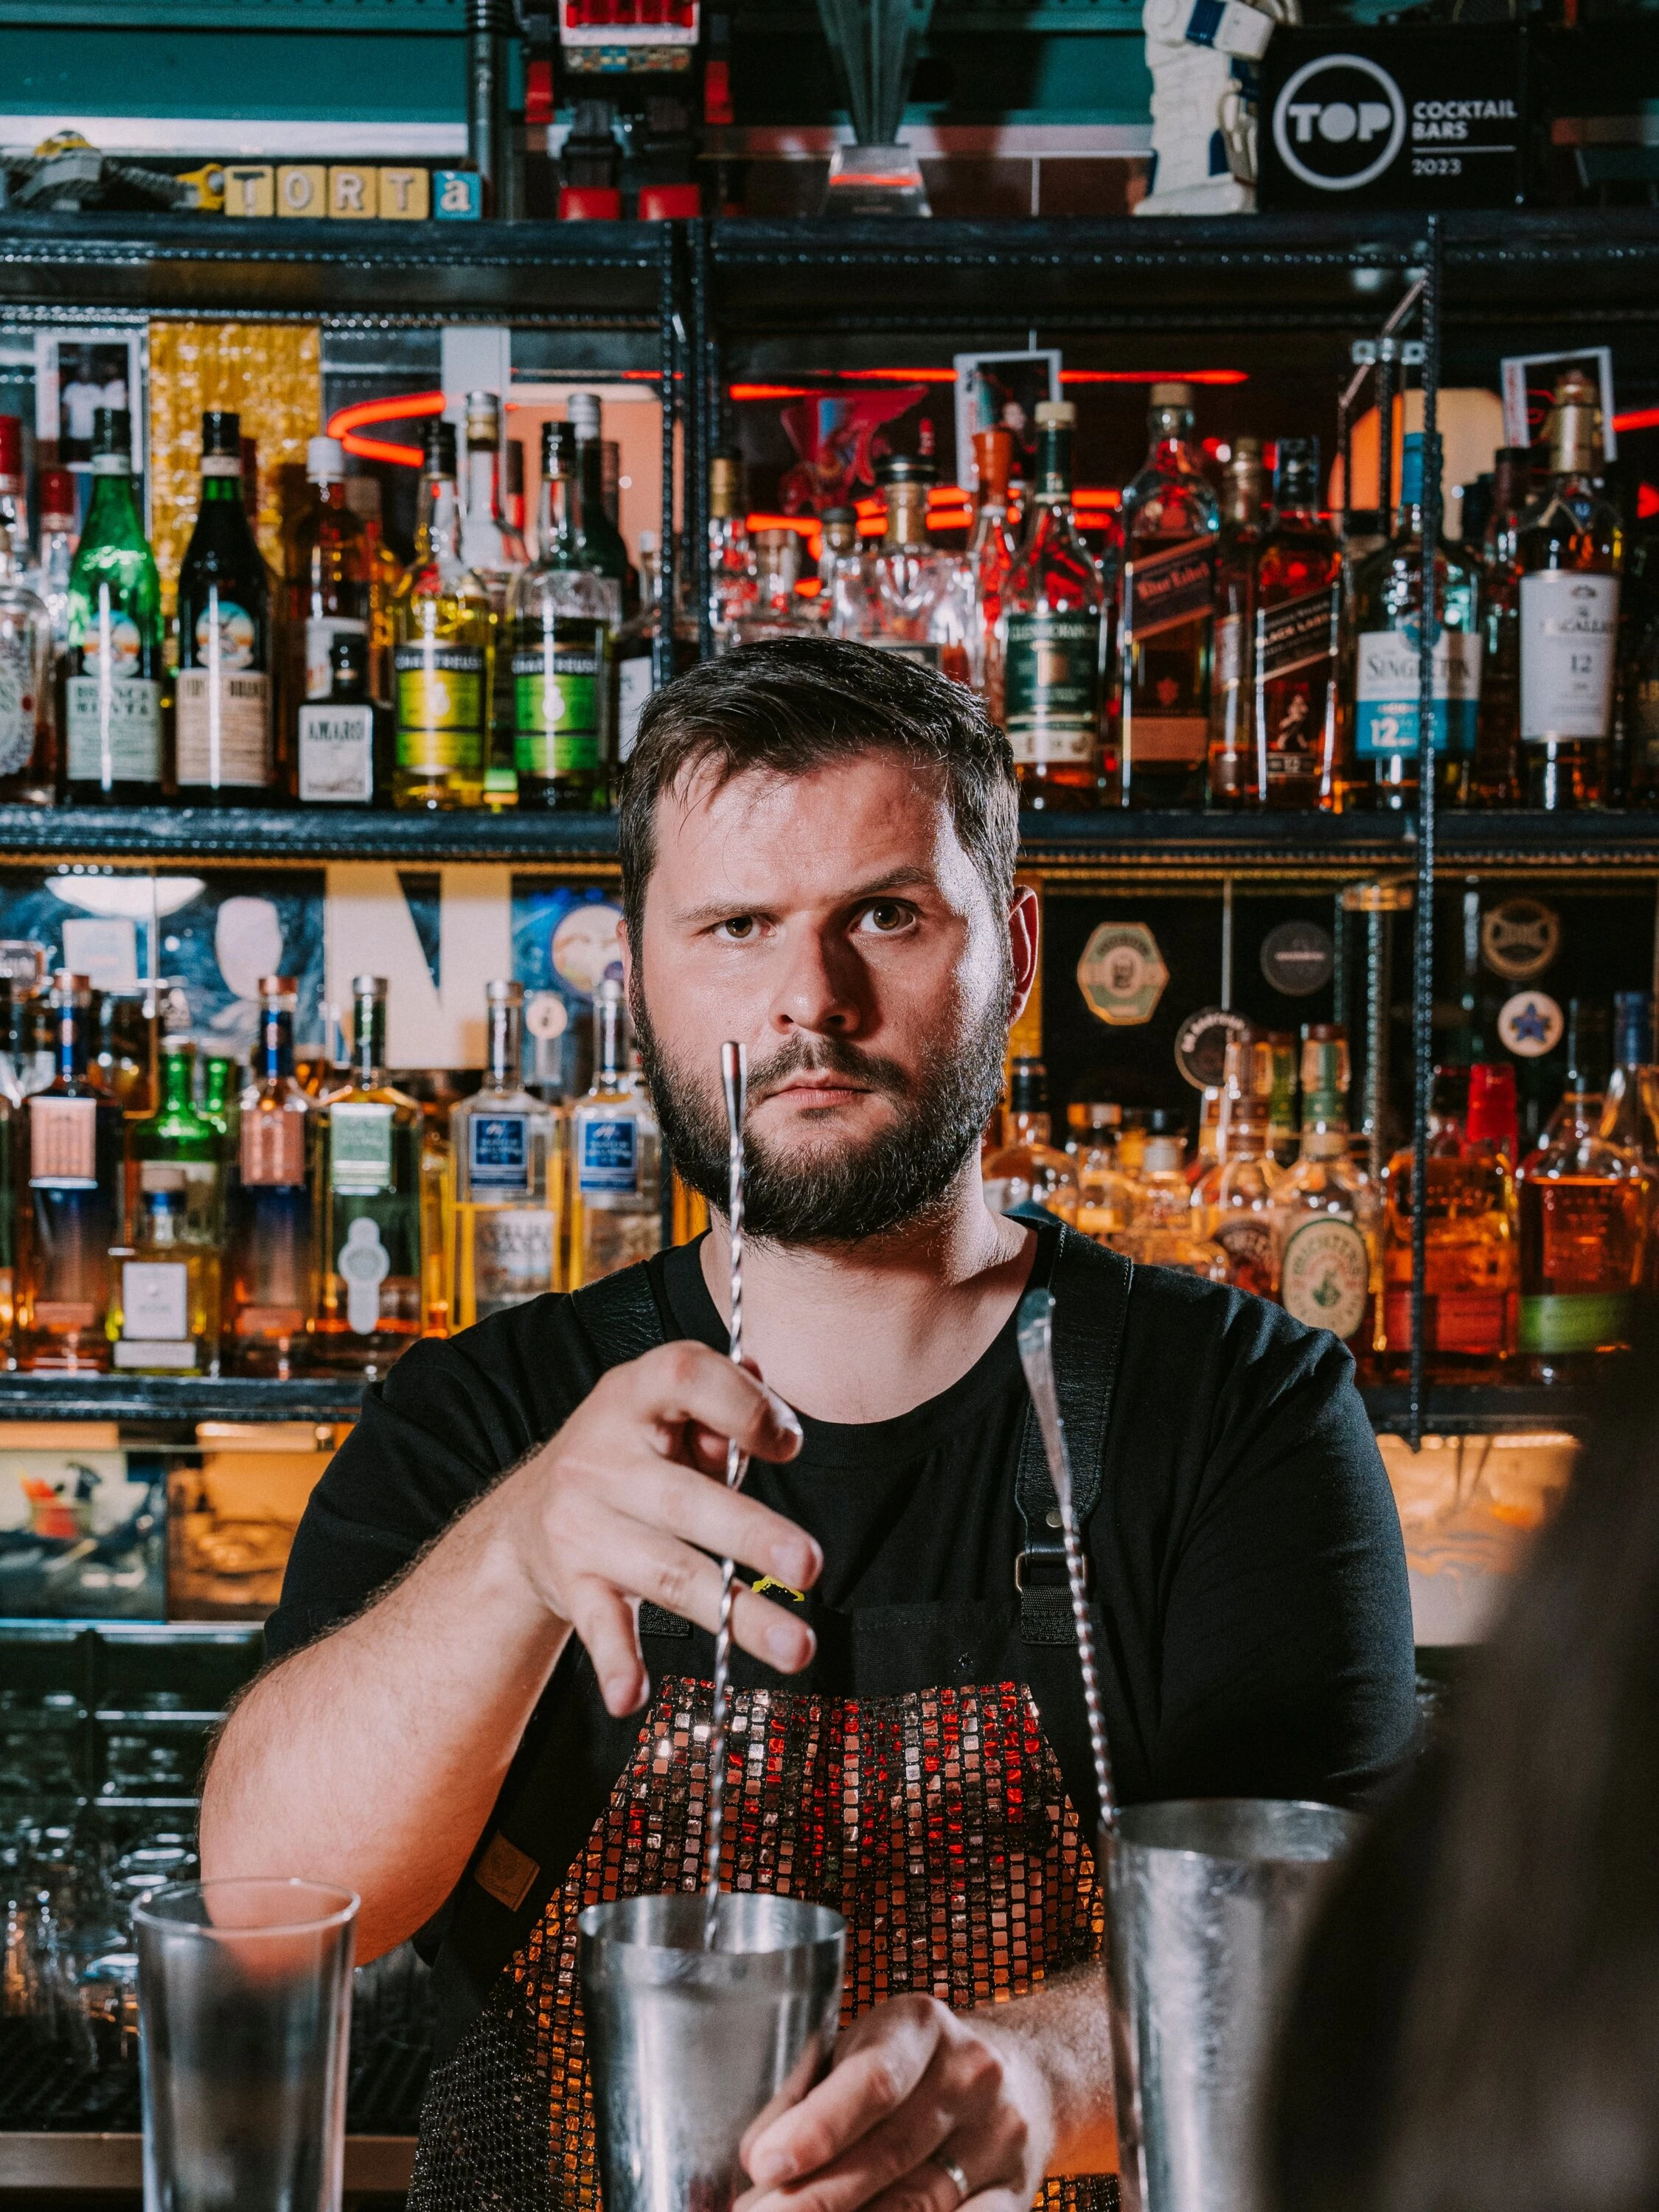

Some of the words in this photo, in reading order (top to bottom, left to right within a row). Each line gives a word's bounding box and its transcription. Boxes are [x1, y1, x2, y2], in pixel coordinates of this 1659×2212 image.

[1412, 99, 1517, 120] COCKTAIL
[1289, 102, 1392, 142] TOP
[1411, 120, 1469, 141] BARS
[1411, 158, 1463, 176] 2023
[1571, 654, 1592, 672] 12
[1370, 716, 1399, 748] 12
